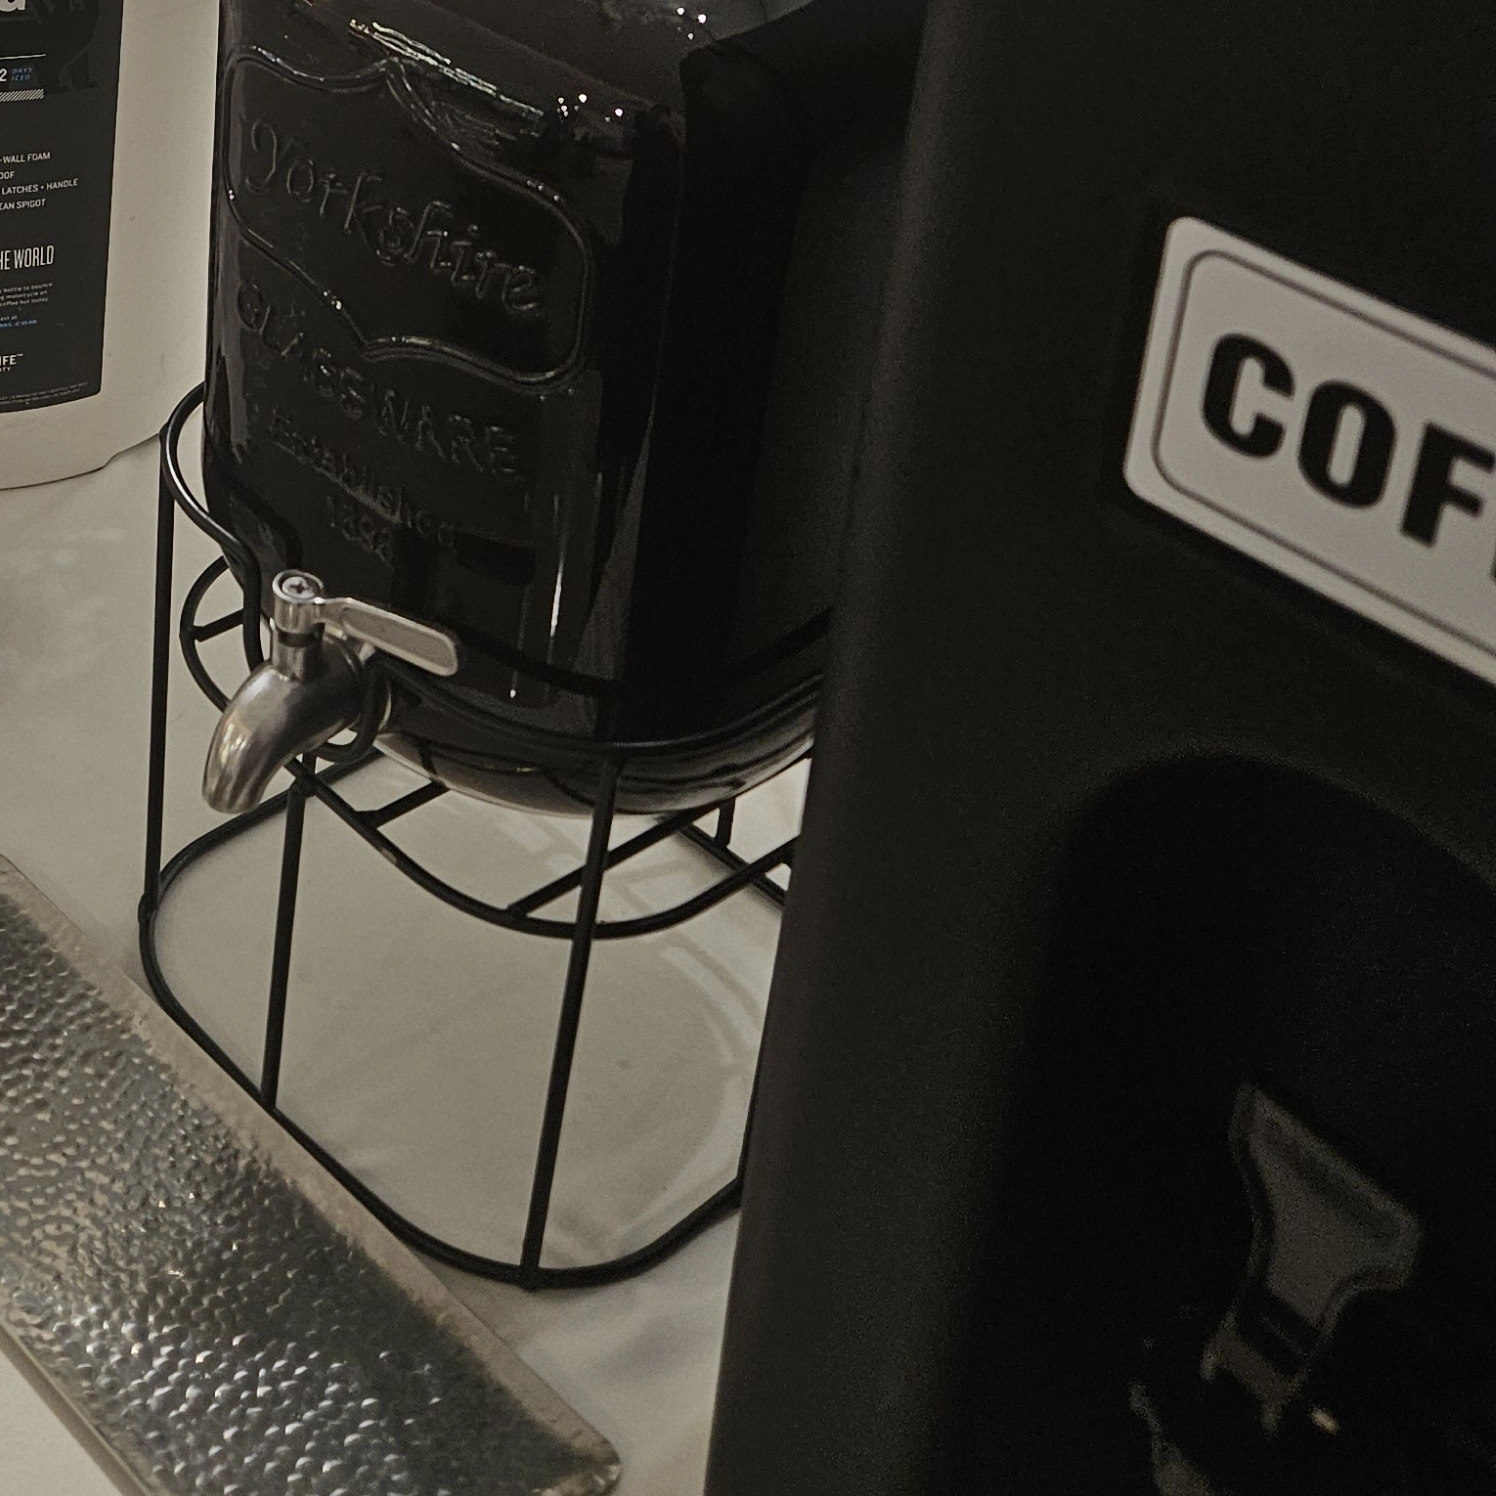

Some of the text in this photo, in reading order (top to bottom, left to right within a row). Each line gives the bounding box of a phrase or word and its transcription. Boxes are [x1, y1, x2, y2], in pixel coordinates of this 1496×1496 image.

[0, 68, 7, 82] 2
[27, 152, 51, 162] FOAM
[2, 184, 38, 195] LATCHES
[46, 178, 78, 190] HANDLE
[17, 199, 46, 209] SPIGOT
[245, 118, 538, 312] Yorkshire
[13, 245, 54, 269] WORLD
[1200, 332, 1496, 581] COF
